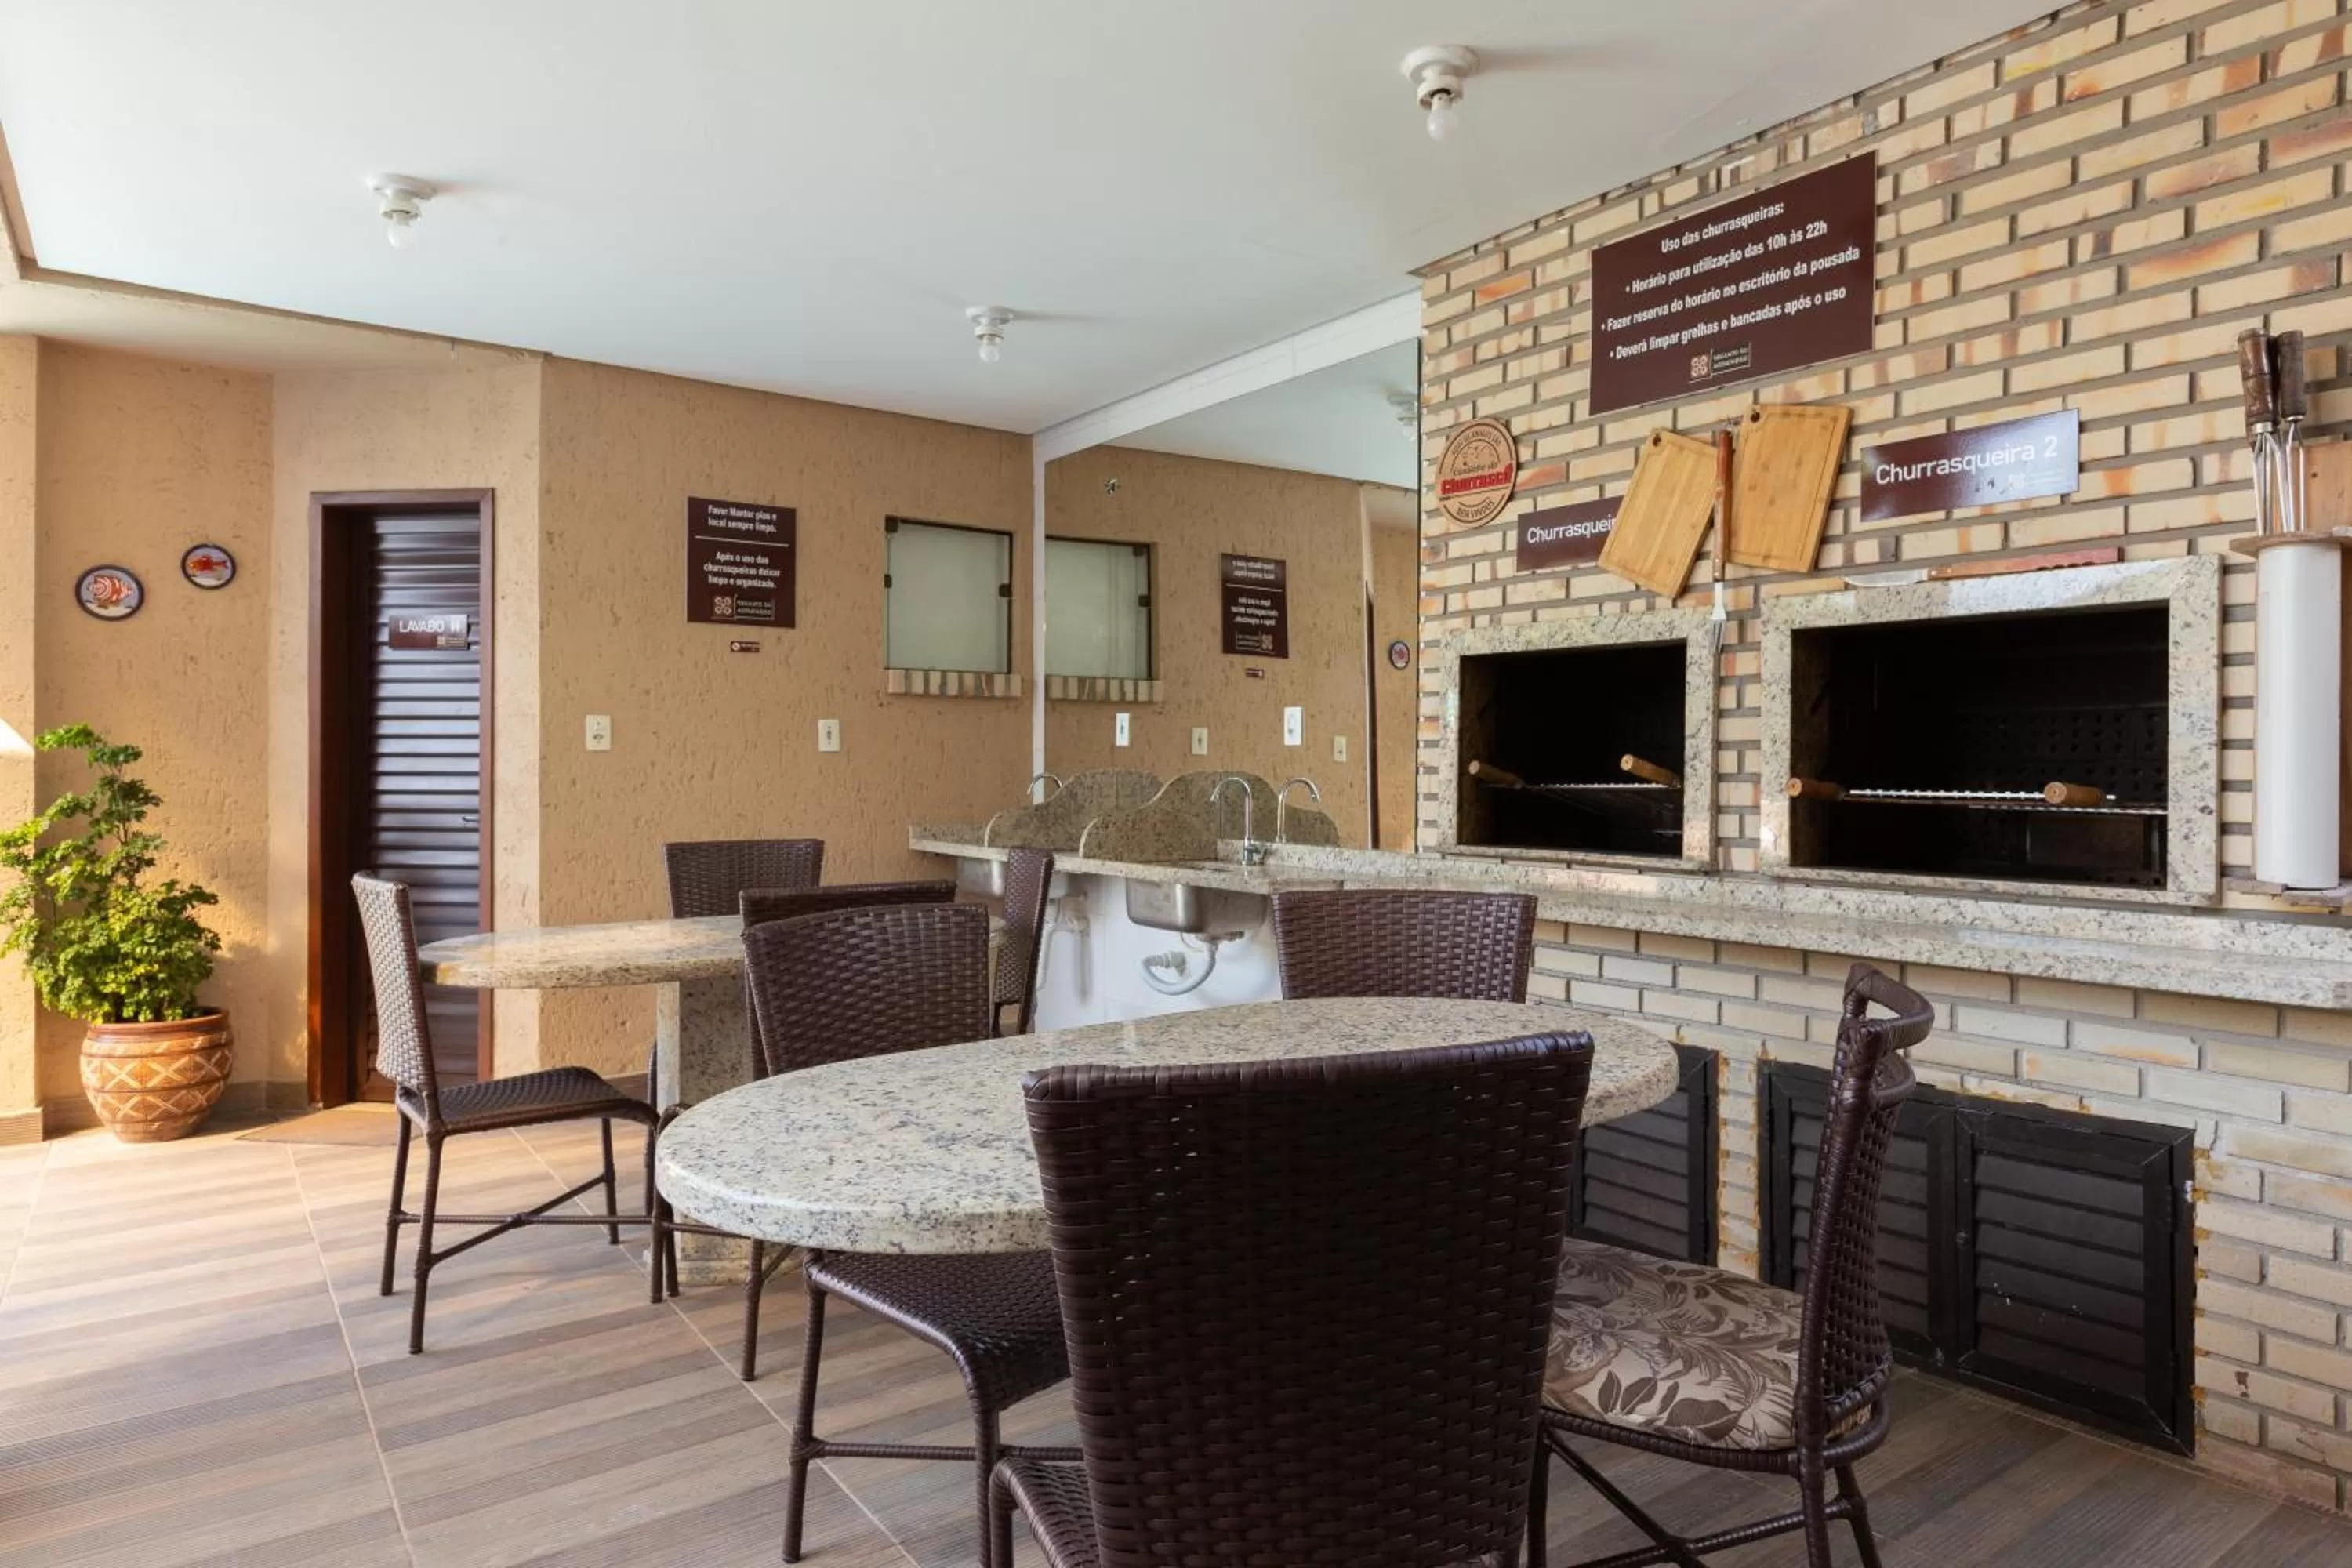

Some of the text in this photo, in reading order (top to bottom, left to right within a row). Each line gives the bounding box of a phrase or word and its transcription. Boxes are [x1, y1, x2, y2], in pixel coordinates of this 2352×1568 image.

[1662, 202, 1784, 252] Uso das churrasqueiras:
[1632, 220, 1827, 293] Horário para utilização das 10h às 22h
[1607, 247, 1860, 331] Fazer reserva do horário no escritório da pousada
[1616, 287, 1846, 359] Deverá limpar grelhas e bancadas após o uso
[1875, 443, 2036, 485] Churrasqueira
[2043, 435, 2059, 459] 2
[708, 504, 728, 516] Favor
[728, 520, 755, 532] sempre
[1526, 514, 1617, 544] Churrasqueir
[742, 555, 755, 564] uso
[398, 619, 445, 633] LAVABO
